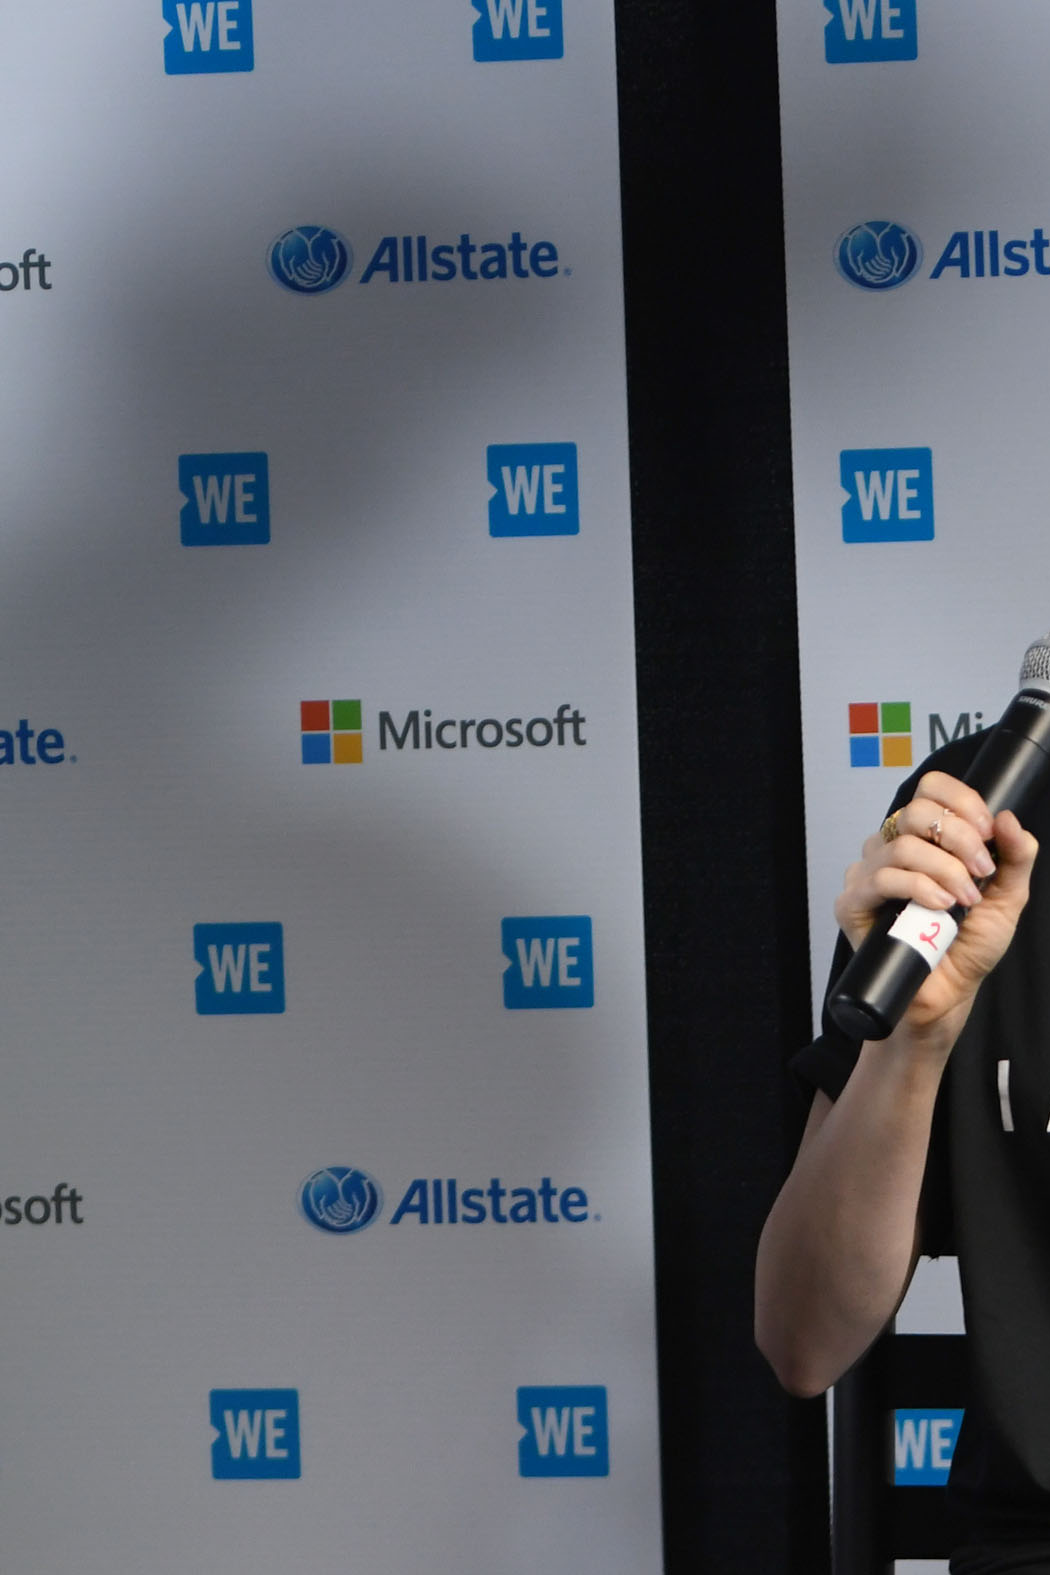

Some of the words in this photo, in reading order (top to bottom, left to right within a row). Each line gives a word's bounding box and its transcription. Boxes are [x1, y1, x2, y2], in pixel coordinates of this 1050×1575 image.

[176, 1, 241, 52] WE
[486, 0, 551, 39] WE
[839, 0, 904, 40] WE
[359, 231, 559, 284] Allstate
[193, 474, 257, 524] WE
[501, 464, 566, 515] WE
[854, 469, 921, 521] WE
[378, 703, 587, 751] Microsoft
[207, 943, 273, 993] WE
[516, 937, 581, 988] WE
[997, 1059, 1014, 1132] I
[0, 1182, 84, 1226] soft
[389, 1177, 588, 1225] Allstate
[223, 1409, 289, 1459] WE
[531, 1406, 596, 1456] WE
[895, 1418, 953, 1469] WE
